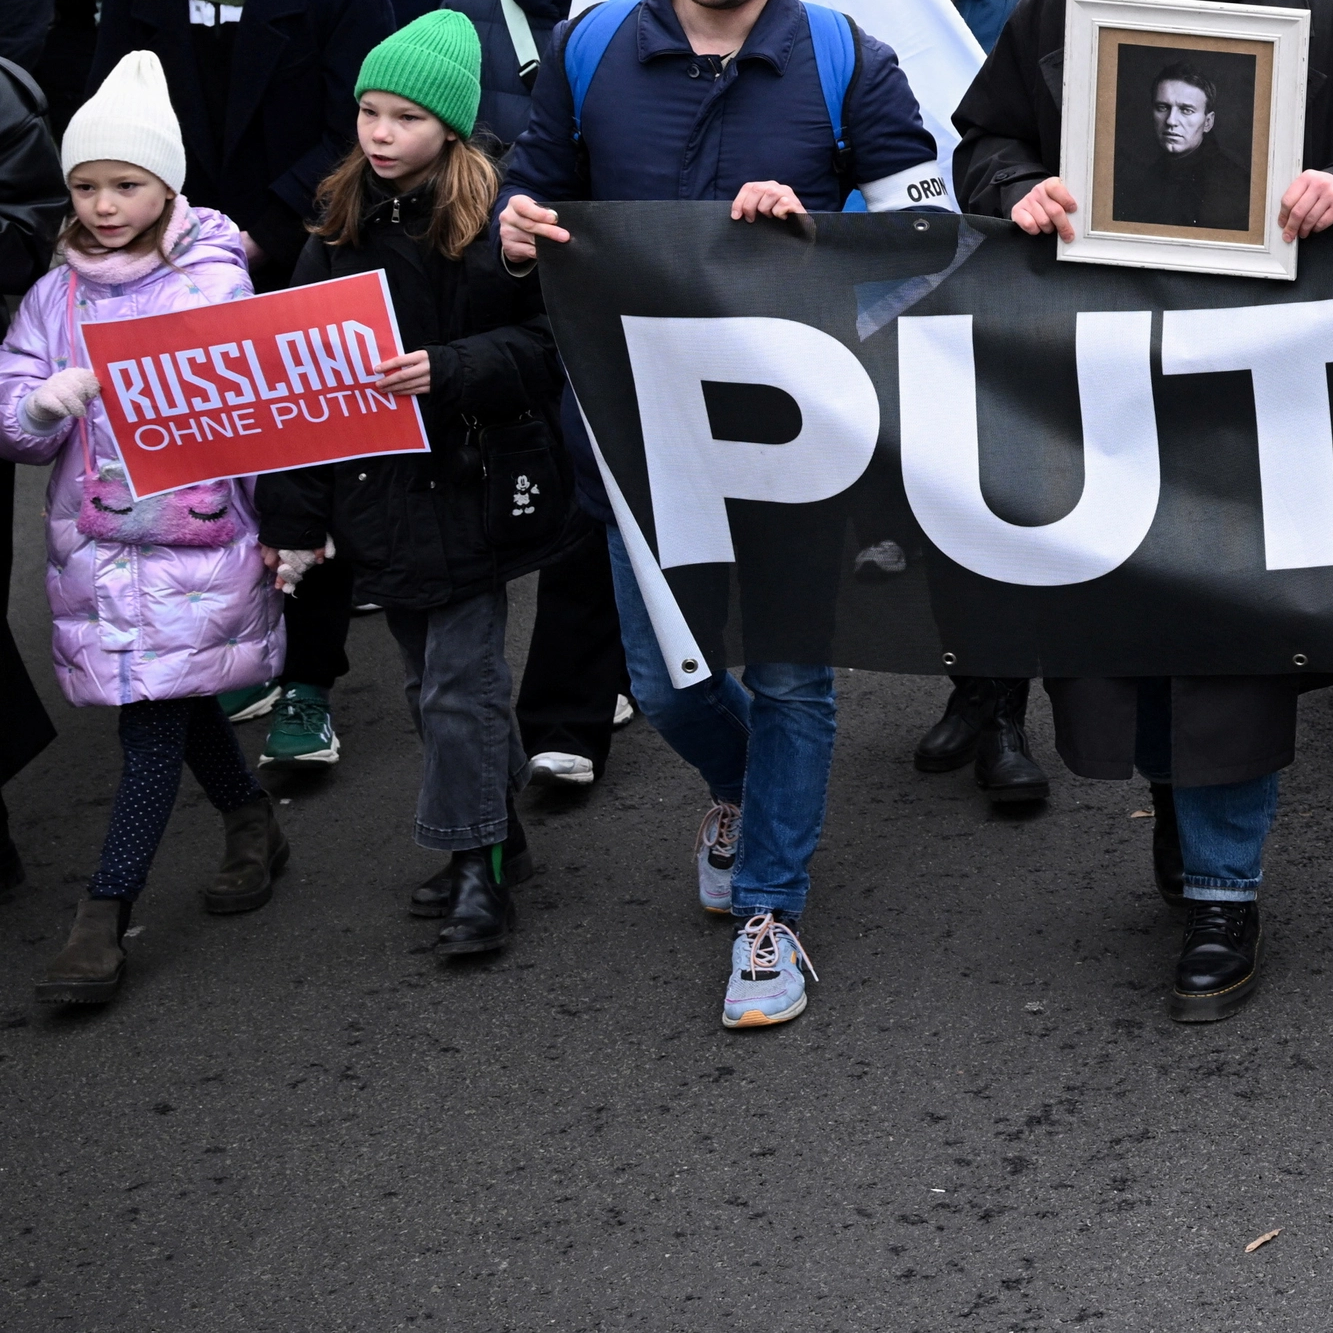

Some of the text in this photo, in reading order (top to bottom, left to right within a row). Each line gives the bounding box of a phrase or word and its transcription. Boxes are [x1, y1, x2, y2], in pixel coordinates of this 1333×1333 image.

[107, 319, 386, 423] RUSSLAND
[134, 387, 397, 451] OHNE PUTIN
